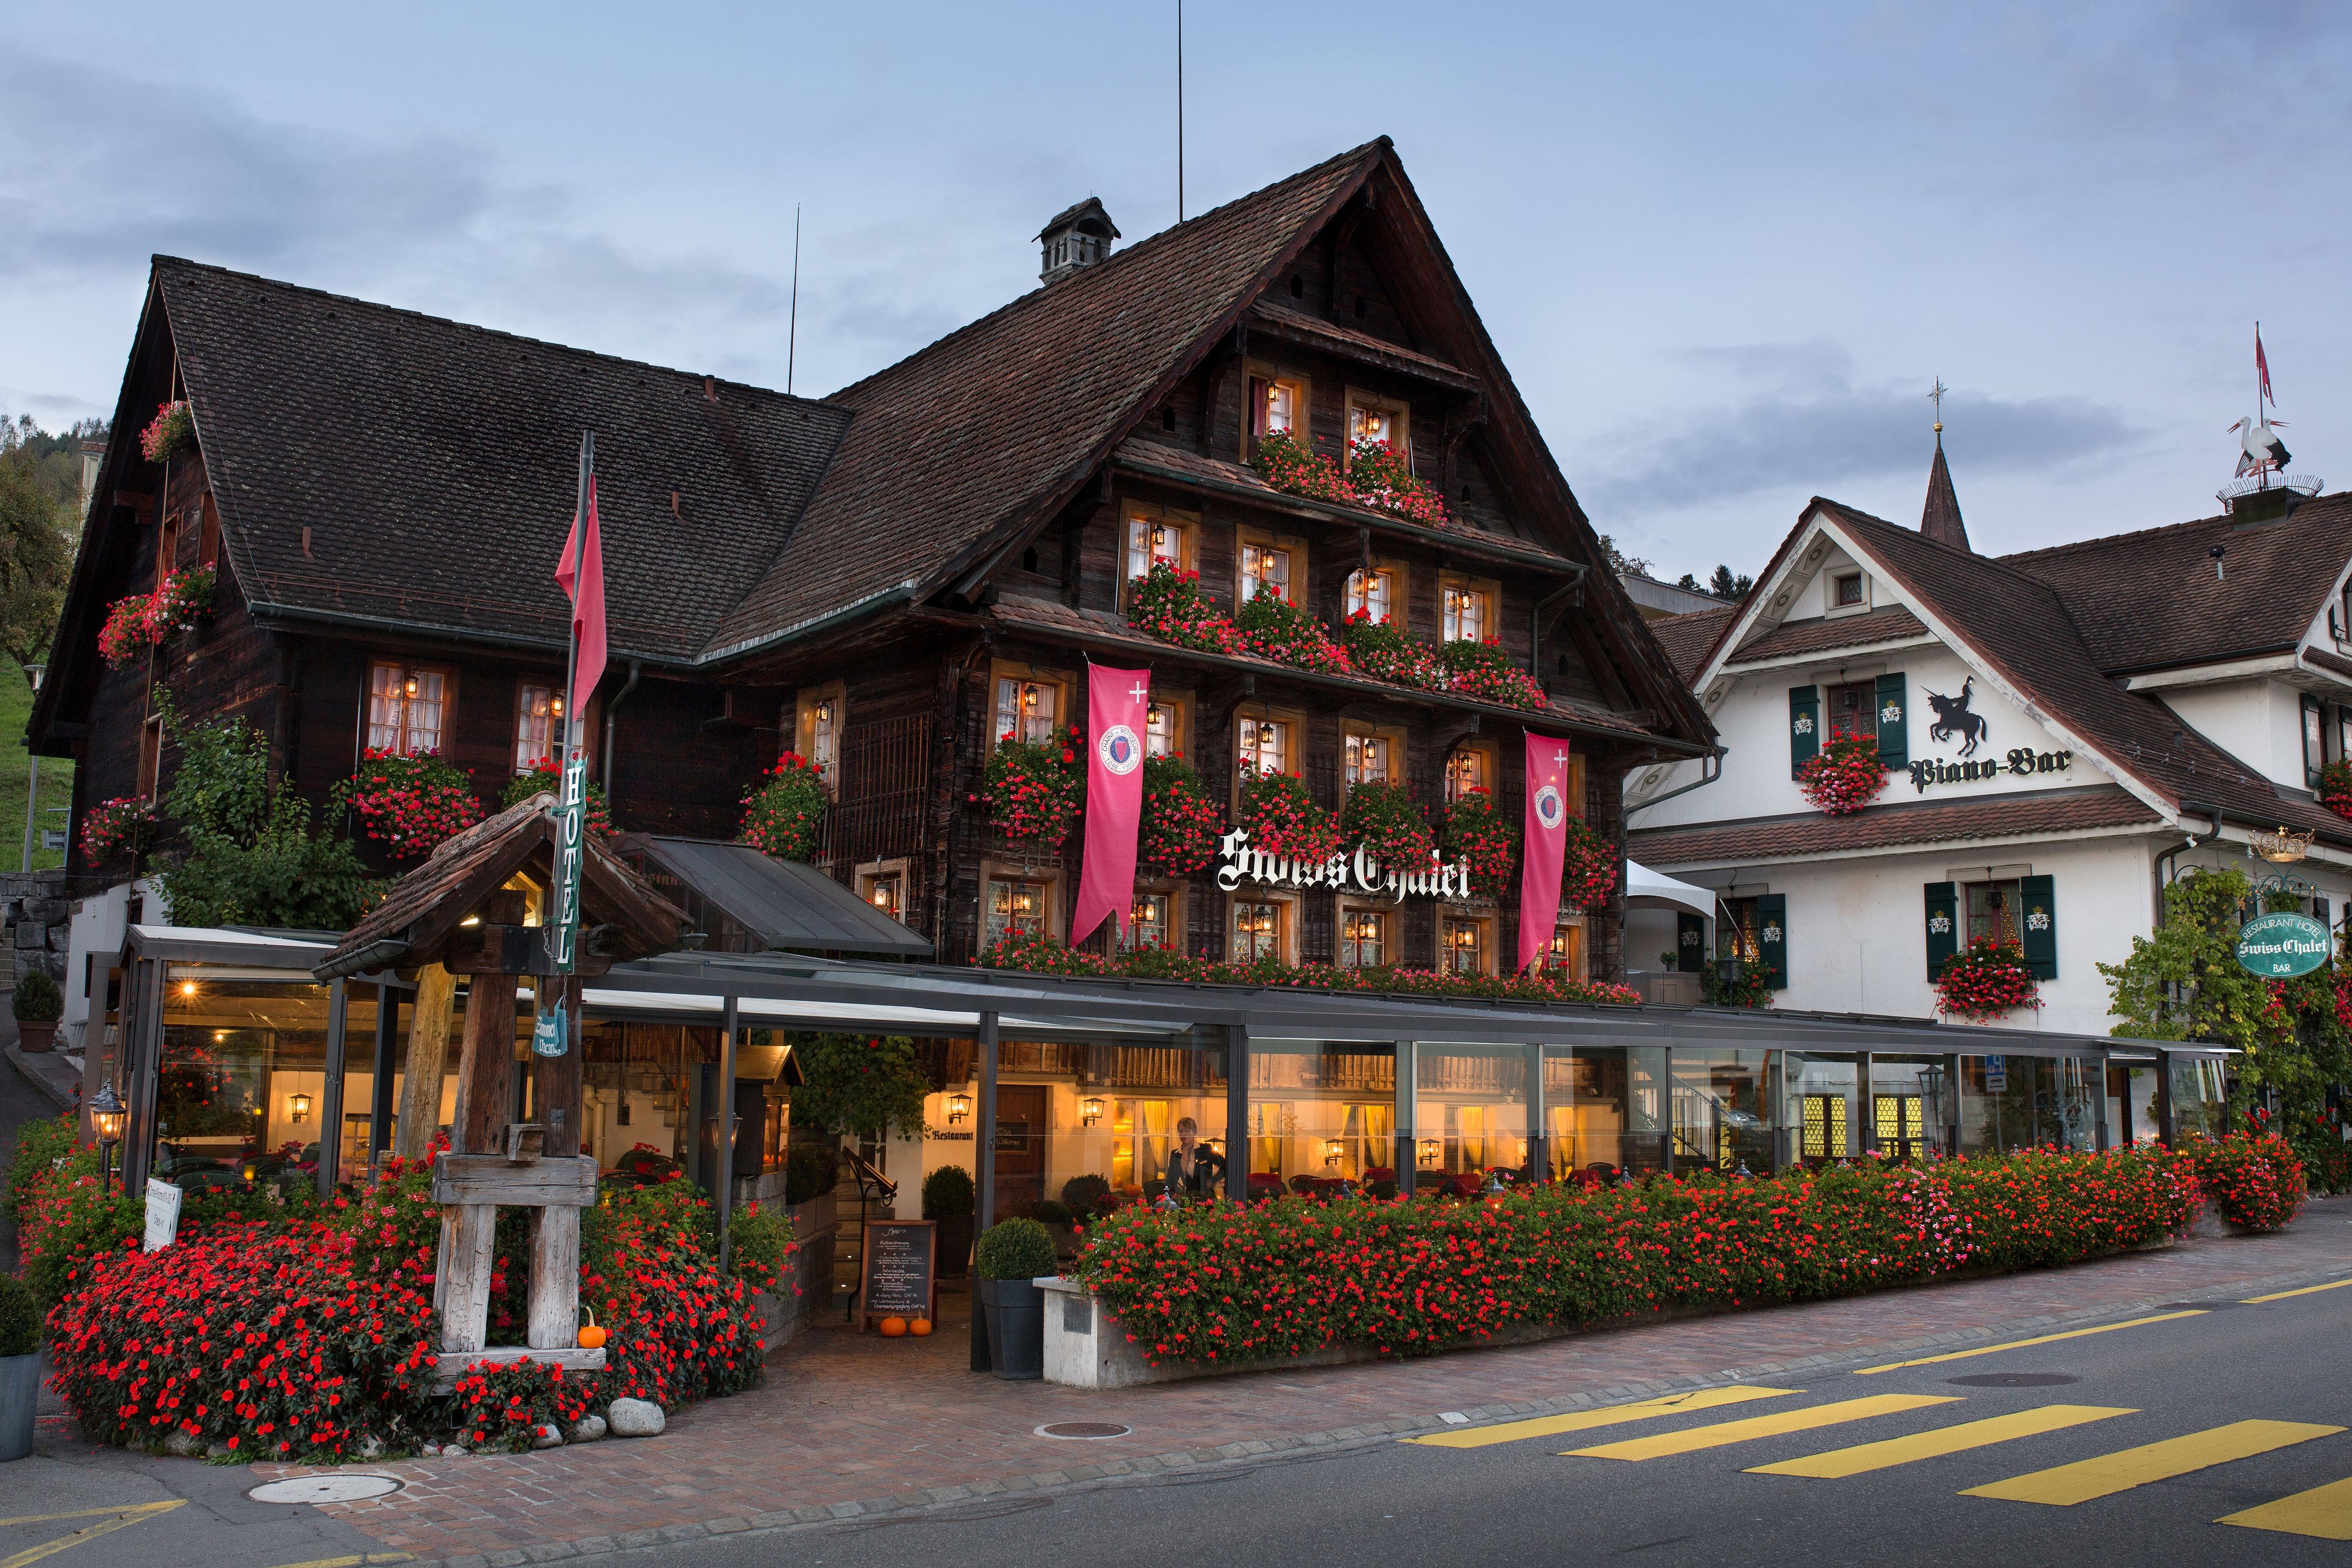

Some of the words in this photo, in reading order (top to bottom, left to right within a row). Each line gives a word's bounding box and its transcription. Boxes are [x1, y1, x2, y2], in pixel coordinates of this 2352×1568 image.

[1907, 747, 2072, 794] Piano-Bar
[557, 767, 582, 965] HOTEL
[2242, 918, 2294, 940] RESTAURANT
[2297, 919, 2321, 939] HOTEL
[2239, 941, 2282, 958] Swiss
[2282, 938, 2328, 956] Chalet
[2273, 963, 2291, 973] BAR
[932, 1130, 974, 1140] Restaurant
